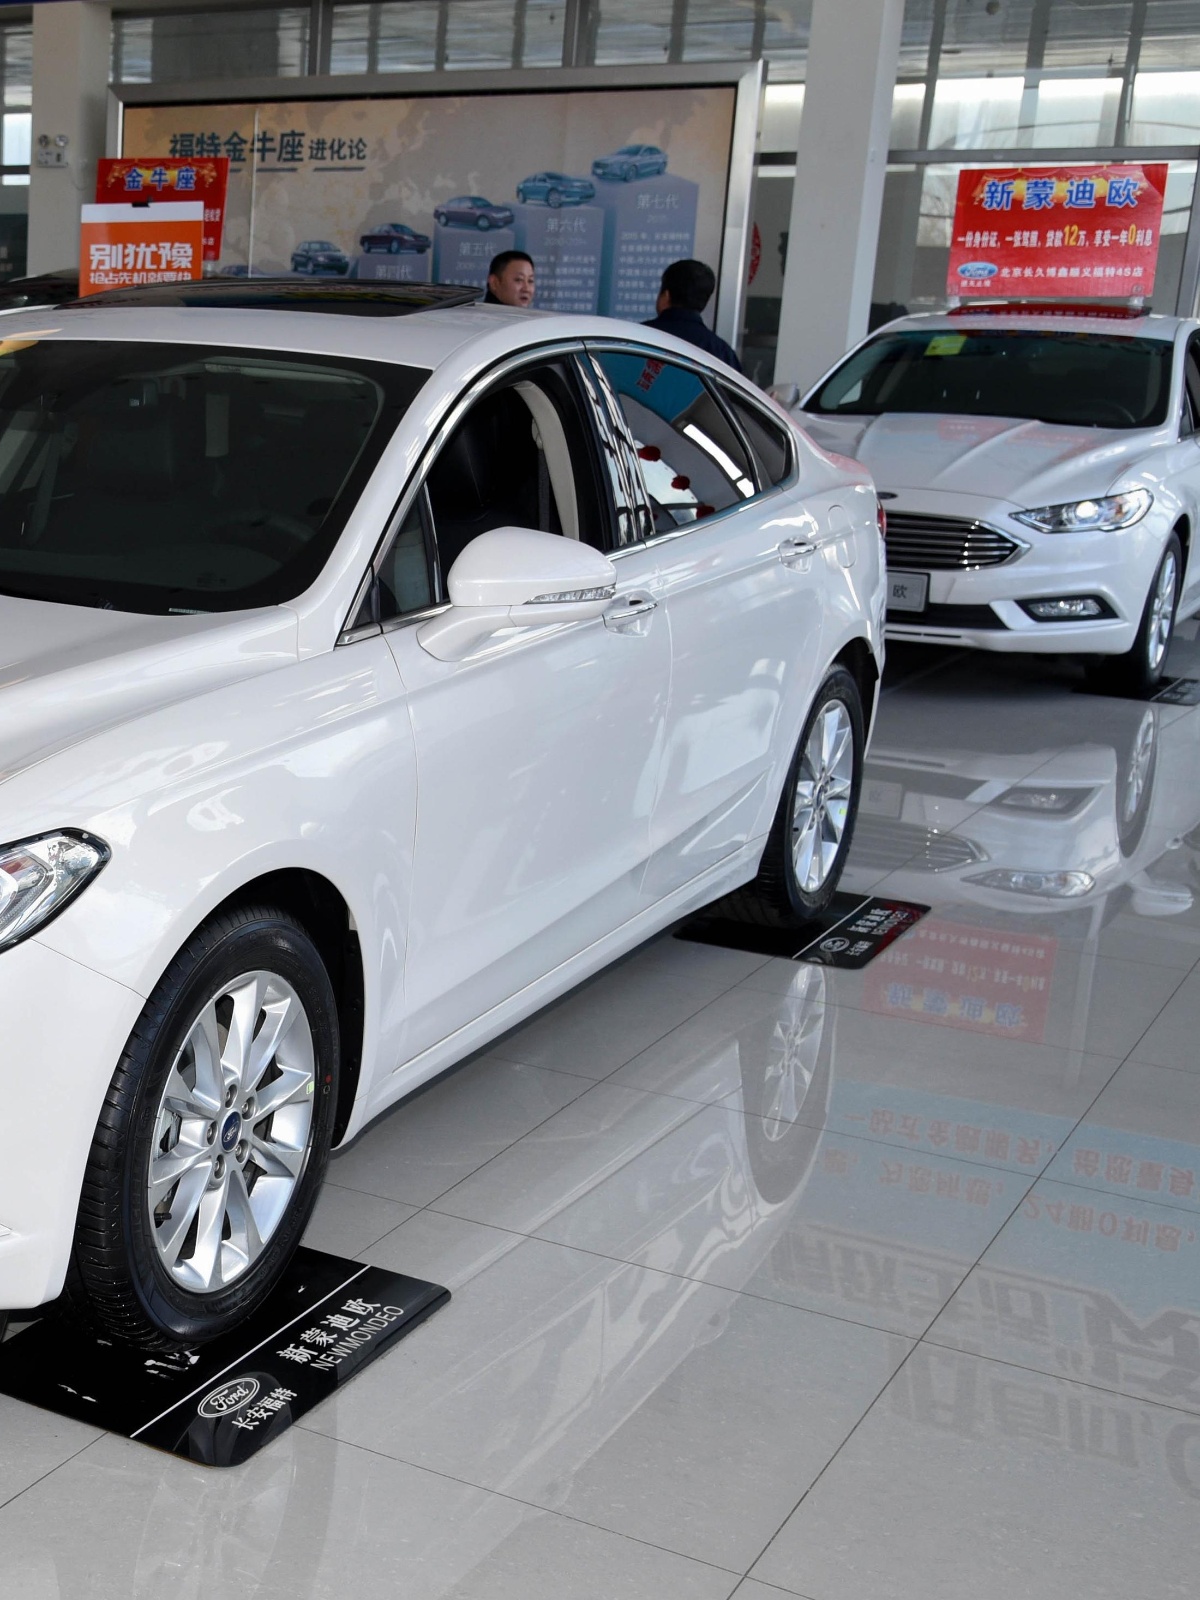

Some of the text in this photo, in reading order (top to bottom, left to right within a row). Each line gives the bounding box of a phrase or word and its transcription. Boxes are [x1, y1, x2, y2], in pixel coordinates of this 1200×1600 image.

[168, 130, 368, 163] 福特金牛座进化论
[123, 166, 197, 191] 金牛座
[636, 193, 680, 210] 第七代
[982, 177, 1140, 211] 新蒙迪欧
[546, 216, 587, 233] 第六代
[89, 241, 193, 270] 别犹豫
[459, 241, 498, 257] 第五代
[89, 271, 193, 285] 抢占先机就要快
[376, 264, 413, 280] 第四代
[276, 1298, 381, 1365] 新蒙迪欧
[231, 1387, 298, 1431] 长安福特
